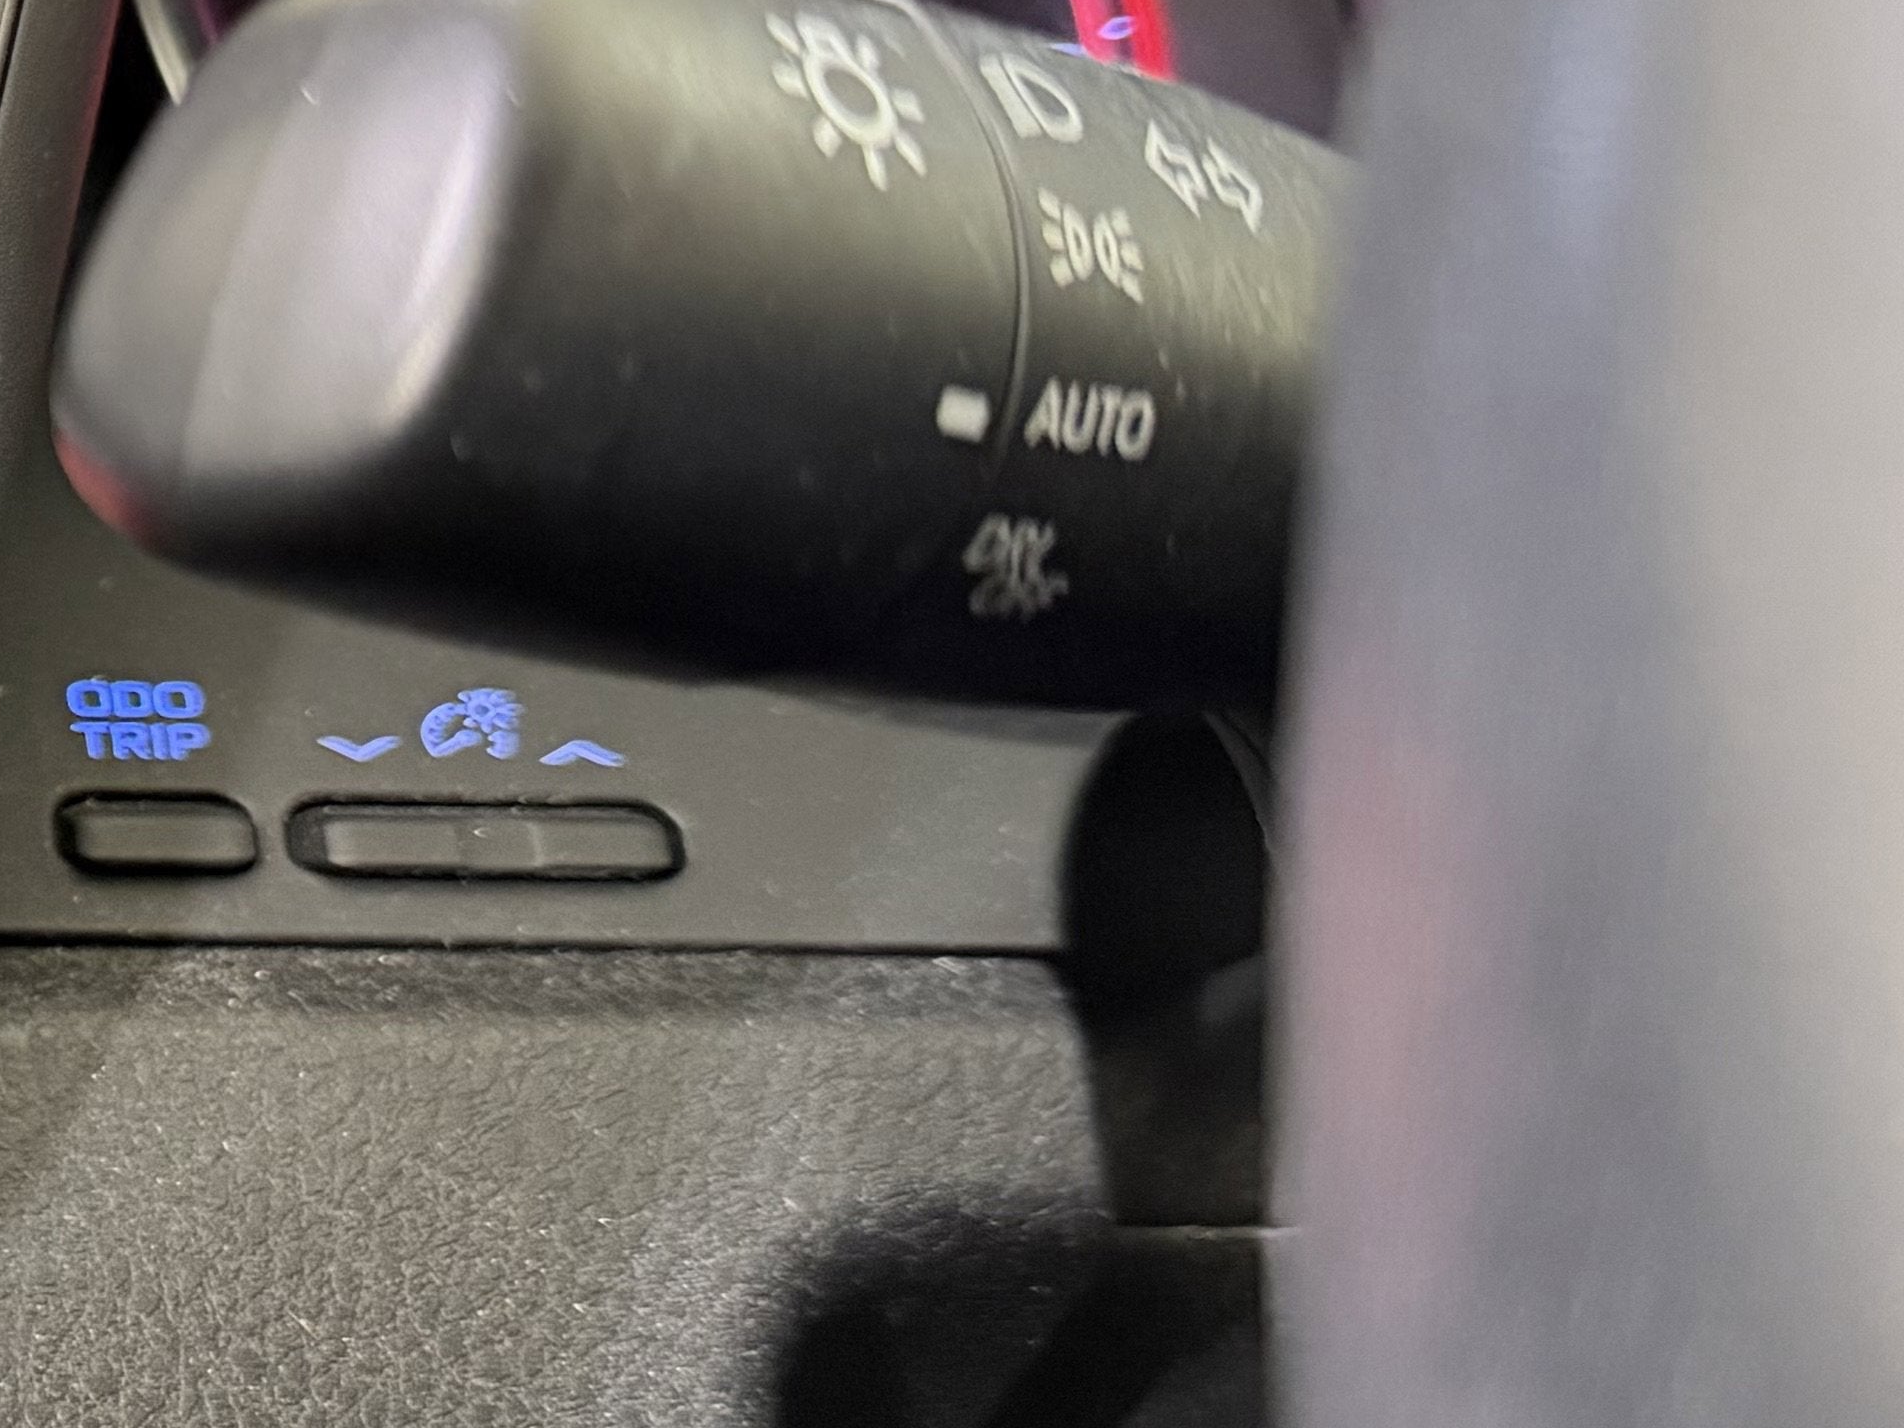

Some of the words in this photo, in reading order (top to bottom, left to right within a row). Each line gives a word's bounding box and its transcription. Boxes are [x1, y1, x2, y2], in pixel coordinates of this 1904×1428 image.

[1023, 375, 1155, 461] AUTO
[65, 678, 205, 720] ODO
[69, 721, 210, 760] TRIP
